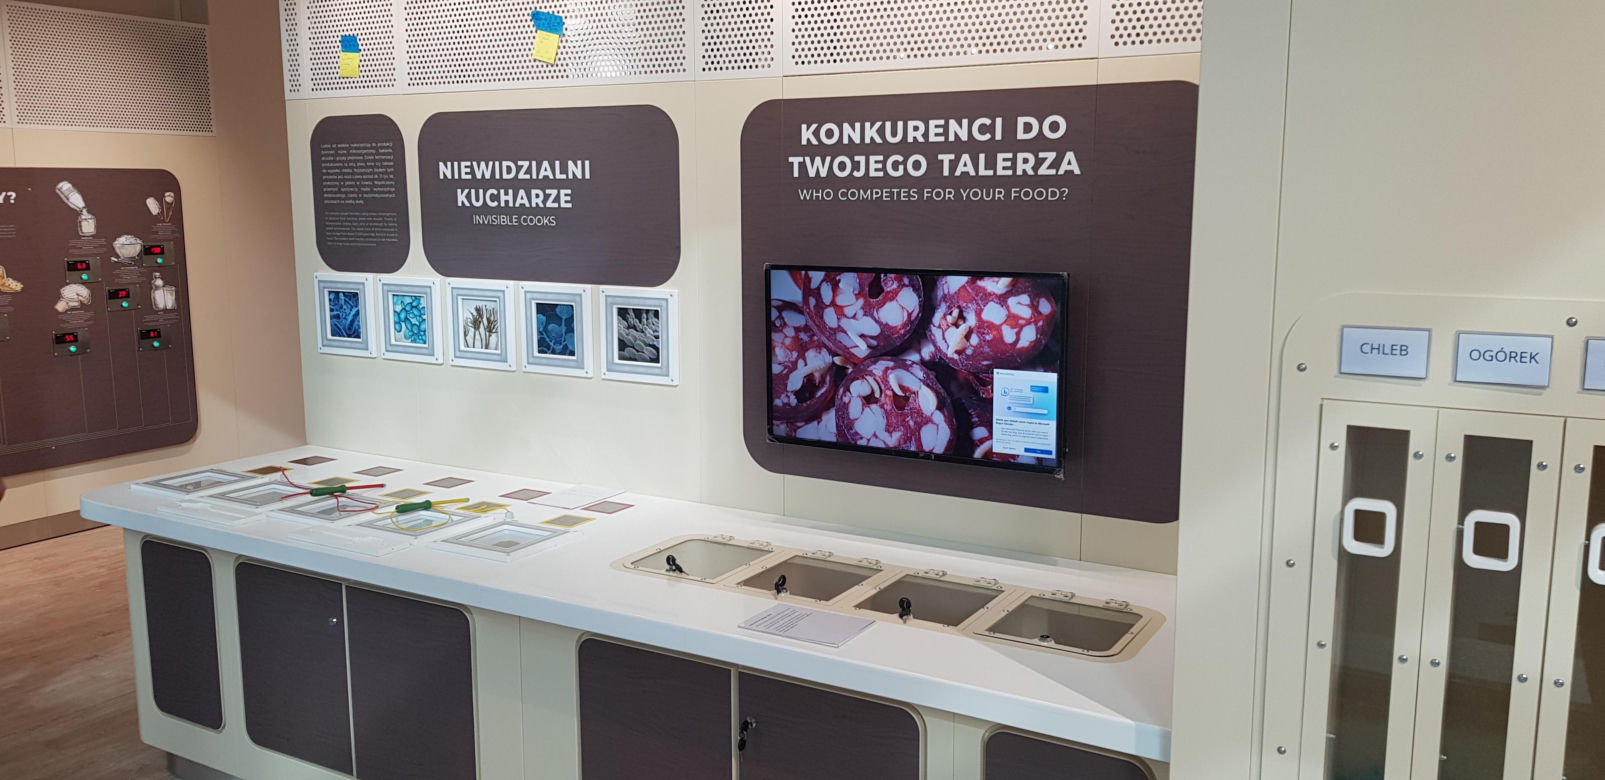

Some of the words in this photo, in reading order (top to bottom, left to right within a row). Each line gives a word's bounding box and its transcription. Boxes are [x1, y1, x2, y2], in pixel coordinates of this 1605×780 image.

[800, 117, 1003, 146] KONKURENCI
[1016, 115, 1067, 140] DO
[438, 160, 591, 180] NIEWIDZIALNI
[788, 154, 928, 178] TWOJEGO
[937, 151, 1081, 177] TALERZA
[456, 188, 573, 208] KUCHARZE
[798, 188, 834, 201] WHO
[838, 188, 918, 201] COMPETES
[923, 188, 955, 201] FOR
[960, 188, 1005, 201] YOUR
[1010, 187, 1069, 201] FOOD?
[472, 214, 519, 226] INVISIBLE
[520, 215, 557, 227] COOKS
[1359, 342, 1409, 357] CHLEB
[1469, 347, 1540, 365] OGÓREK
